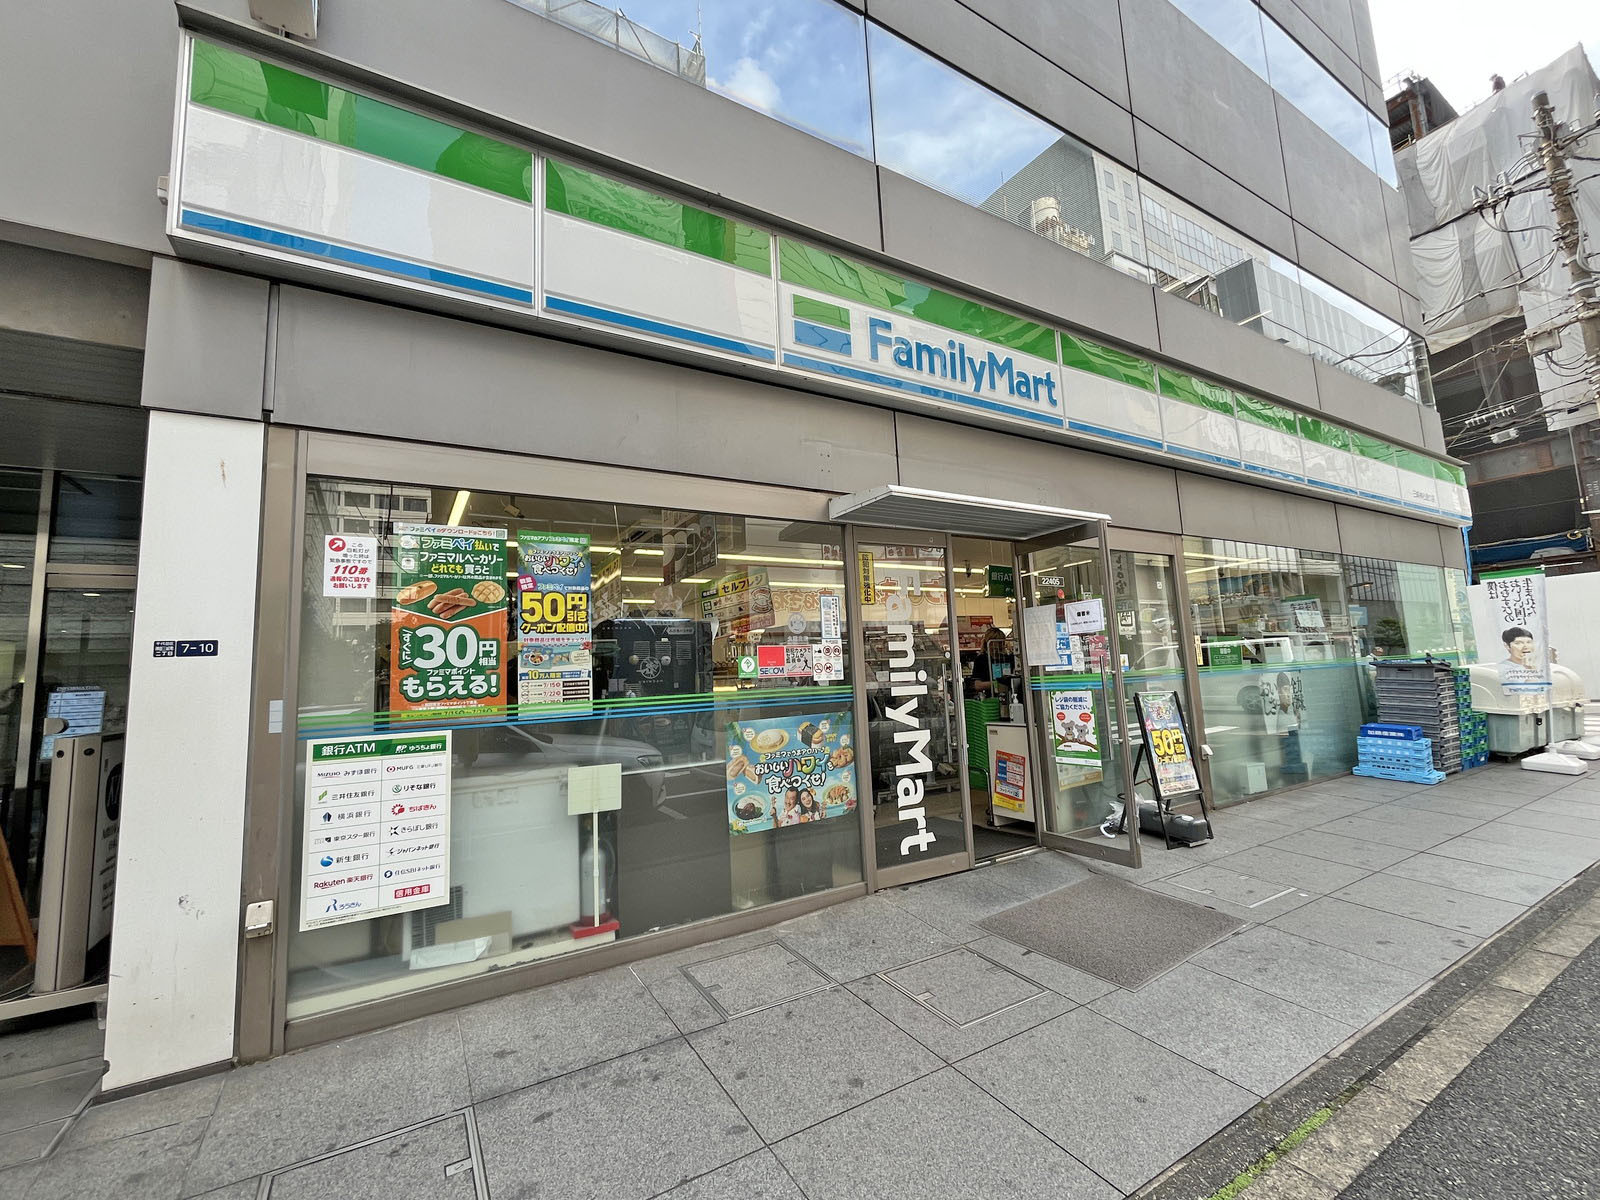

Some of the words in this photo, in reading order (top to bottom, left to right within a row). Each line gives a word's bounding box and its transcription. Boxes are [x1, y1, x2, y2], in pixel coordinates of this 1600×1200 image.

[868, 316, 1058, 407] FamilyMart
[421, 536, 500, 551] ファミペイ払いで
[420, 552, 504, 564] ファミマルベーカリー
[333, 564, 369, 575] 110番
[431, 564, 490, 575] どれでも買うと
[991, 571, 1012, 582] 銀行AT
[1041, 577, 1060, 586] 22405
[520, 622, 589, 634] クーポン配信中!
[181, 643, 214, 653] 7-10
[402, 633, 412, 661] すぐに
[478, 657, 497, 666] 相当
[427, 667, 476, 676] ファミマポイント
[759, 667, 785, 675] SECOM
[403, 674, 498, 698] もらえる!
[885, 568, 938, 857] FamilyMart
[321, 743, 376, 757] 銀行ATM
[409, 743, 442, 751] ゆうちょ銀行
[755, 754, 834, 777] おいしいハワイを
[343, 768, 377, 777] みずほ銀行
[403, 783, 436, 791] りそな銀行
[765, 773, 826, 794] 食べつくせ!
[331, 790, 375, 801] 三井住友銀行
[337, 810, 372, 820] 横浜銀行
[400, 822, 438, 834] きらぼし銀行
[334, 831, 376, 842] 東京スター銀行
[397, 843, 440, 854] ジャパンネット銀行
[336, 852, 369, 863] 新生銀行
[395, 864, 441, 876] 住信SBIネット銀行
[313, 878, 346, 889] Rakuten
[346, 874, 374, 884] 楽天銀行
[395, 885, 430, 897] 信用金庫
[339, 901, 362, 910] ろうきん
